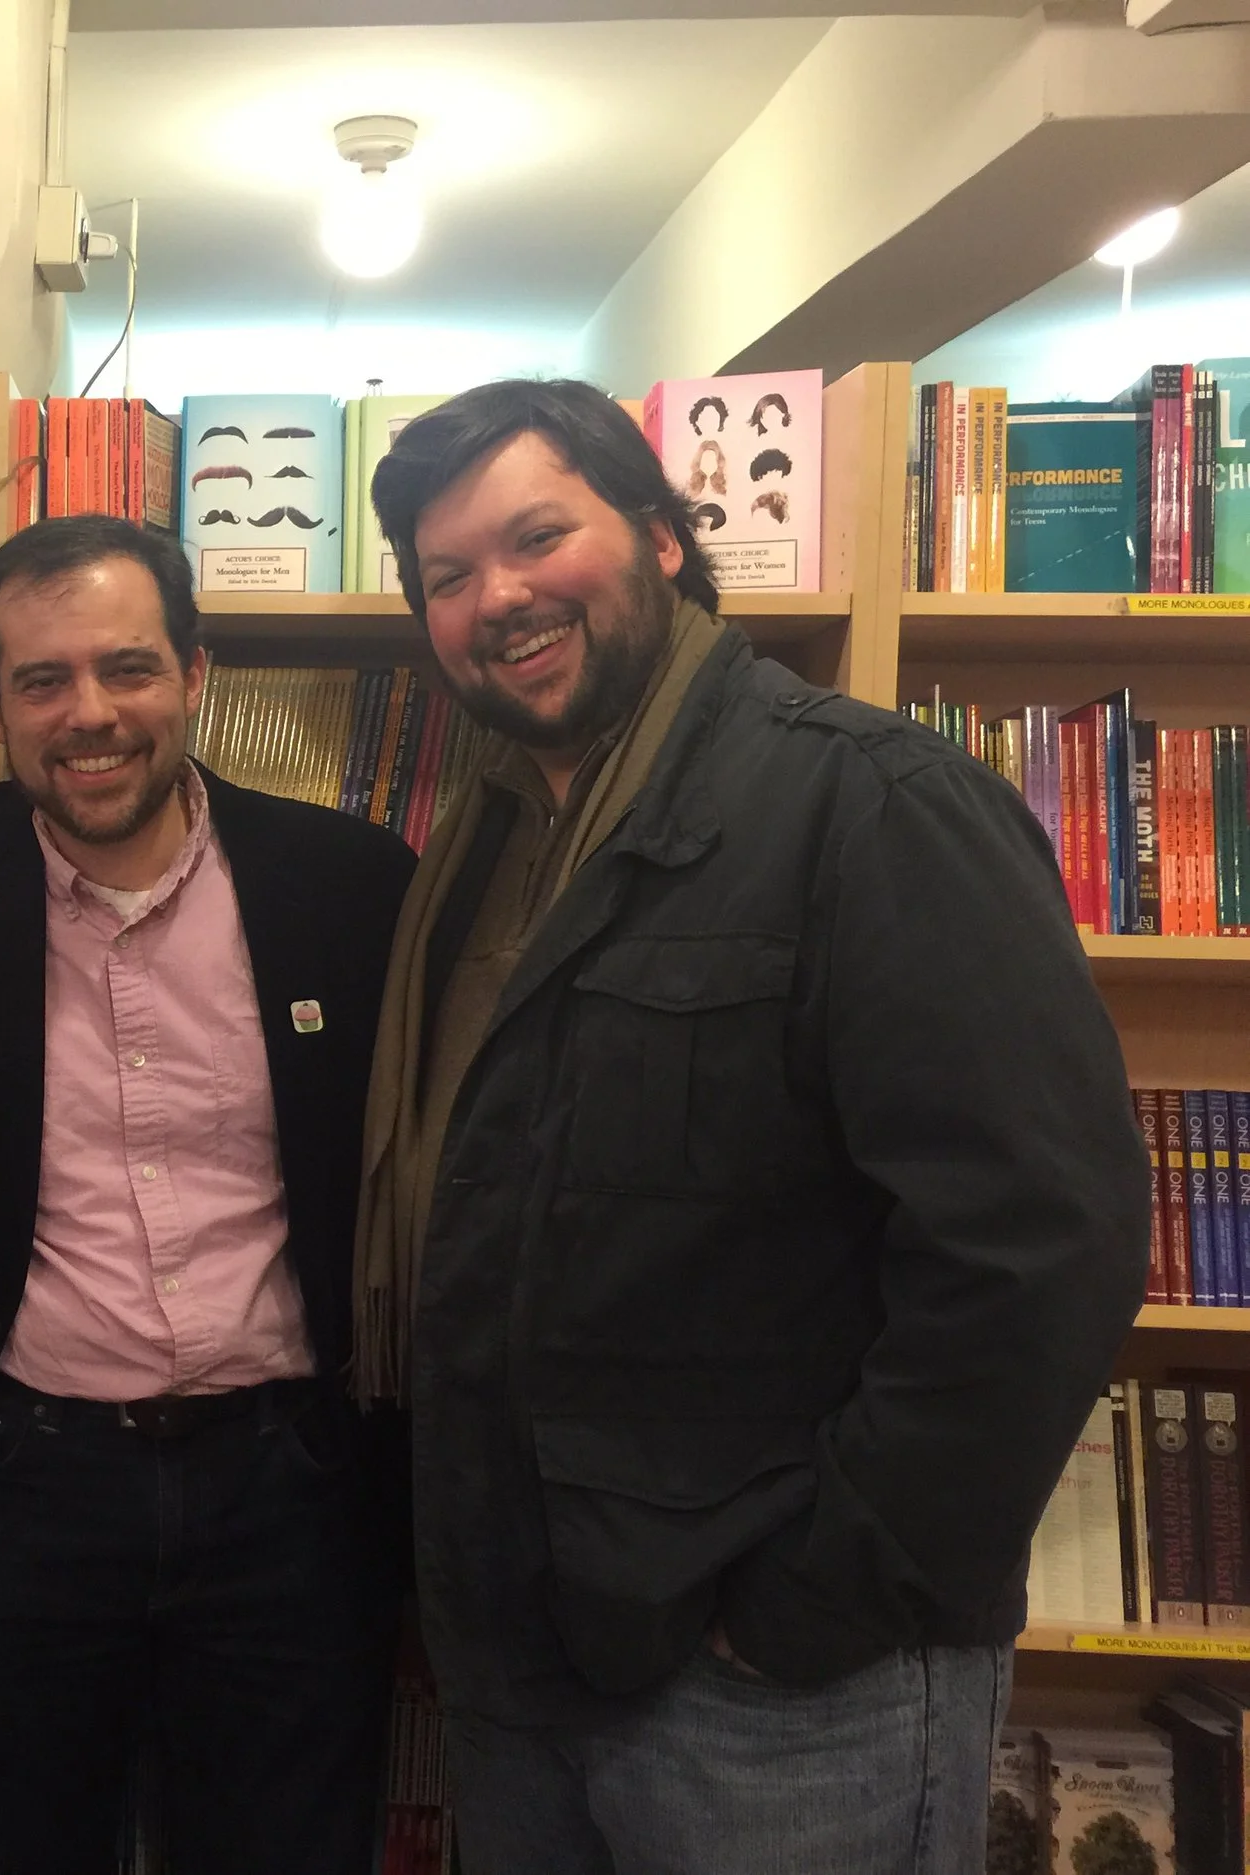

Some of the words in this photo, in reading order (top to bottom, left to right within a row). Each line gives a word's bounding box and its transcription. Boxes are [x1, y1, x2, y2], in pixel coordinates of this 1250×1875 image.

[957, 404, 966, 414] IN
[975, 402, 984, 412] IN
[993, 402, 1003, 412] IN
[955, 419, 965, 496] PERFORMANCE
[974, 417, 983, 495] PERFORMANCE
[992, 417, 1002, 495] PERFORMANCE
[1010, 505, 1067, 516] Contemporary
[1069, 504, 1118, 514] Monologues
[1010, 518, 1021, 526] for
[1024, 517, 1047, 525] Teens
[216, 568, 257, 576] Monologues
[754, 562, 786, 570] Women
[1139, 601, 1168, 609] MORE
[1171, 600, 1245, 609] MONOLOGUES
[1097, 714, 1106, 774] MONOLOGUES
[1099, 775, 1106, 788] ON
[1135, 760, 1152, 800] THE
[1049, 812, 1058, 825] for
[1099, 817, 1107, 834] LIFE
[1137, 807, 1153, 862] MOTH
[1142, 1114, 1156, 1146] ONE
[1166, 1115, 1180, 1147] ONE
[1189, 1116, 1203, 1148] ONE
[1212, 1114, 1226, 1146] ONE
[1236, 1116, 1249, 1148] ONE
[1169, 1171, 1183, 1203] ONE
[1192, 1172, 1206, 1205] ONE
[1215, 1171, 1230, 1204] ONE
[1239, 1174, 1250, 1206] ONE
[1159, 1456, 1180, 1535] DOROTHY
[1209, 1459, 1230, 1539] DOROTHY
[1164, 1538, 1183, 1598] PARKER
[1214, 1541, 1232, 1601] PARKER
[1097, 1638, 1124, 1648] MORE
[1128, 1639, 1199, 1651] MONOLOGUES
[1201, 1643, 1214, 1652] AT
[1216, 1644, 1233, 1653] THE
[1064, 1772, 1113, 1793] Spoon
